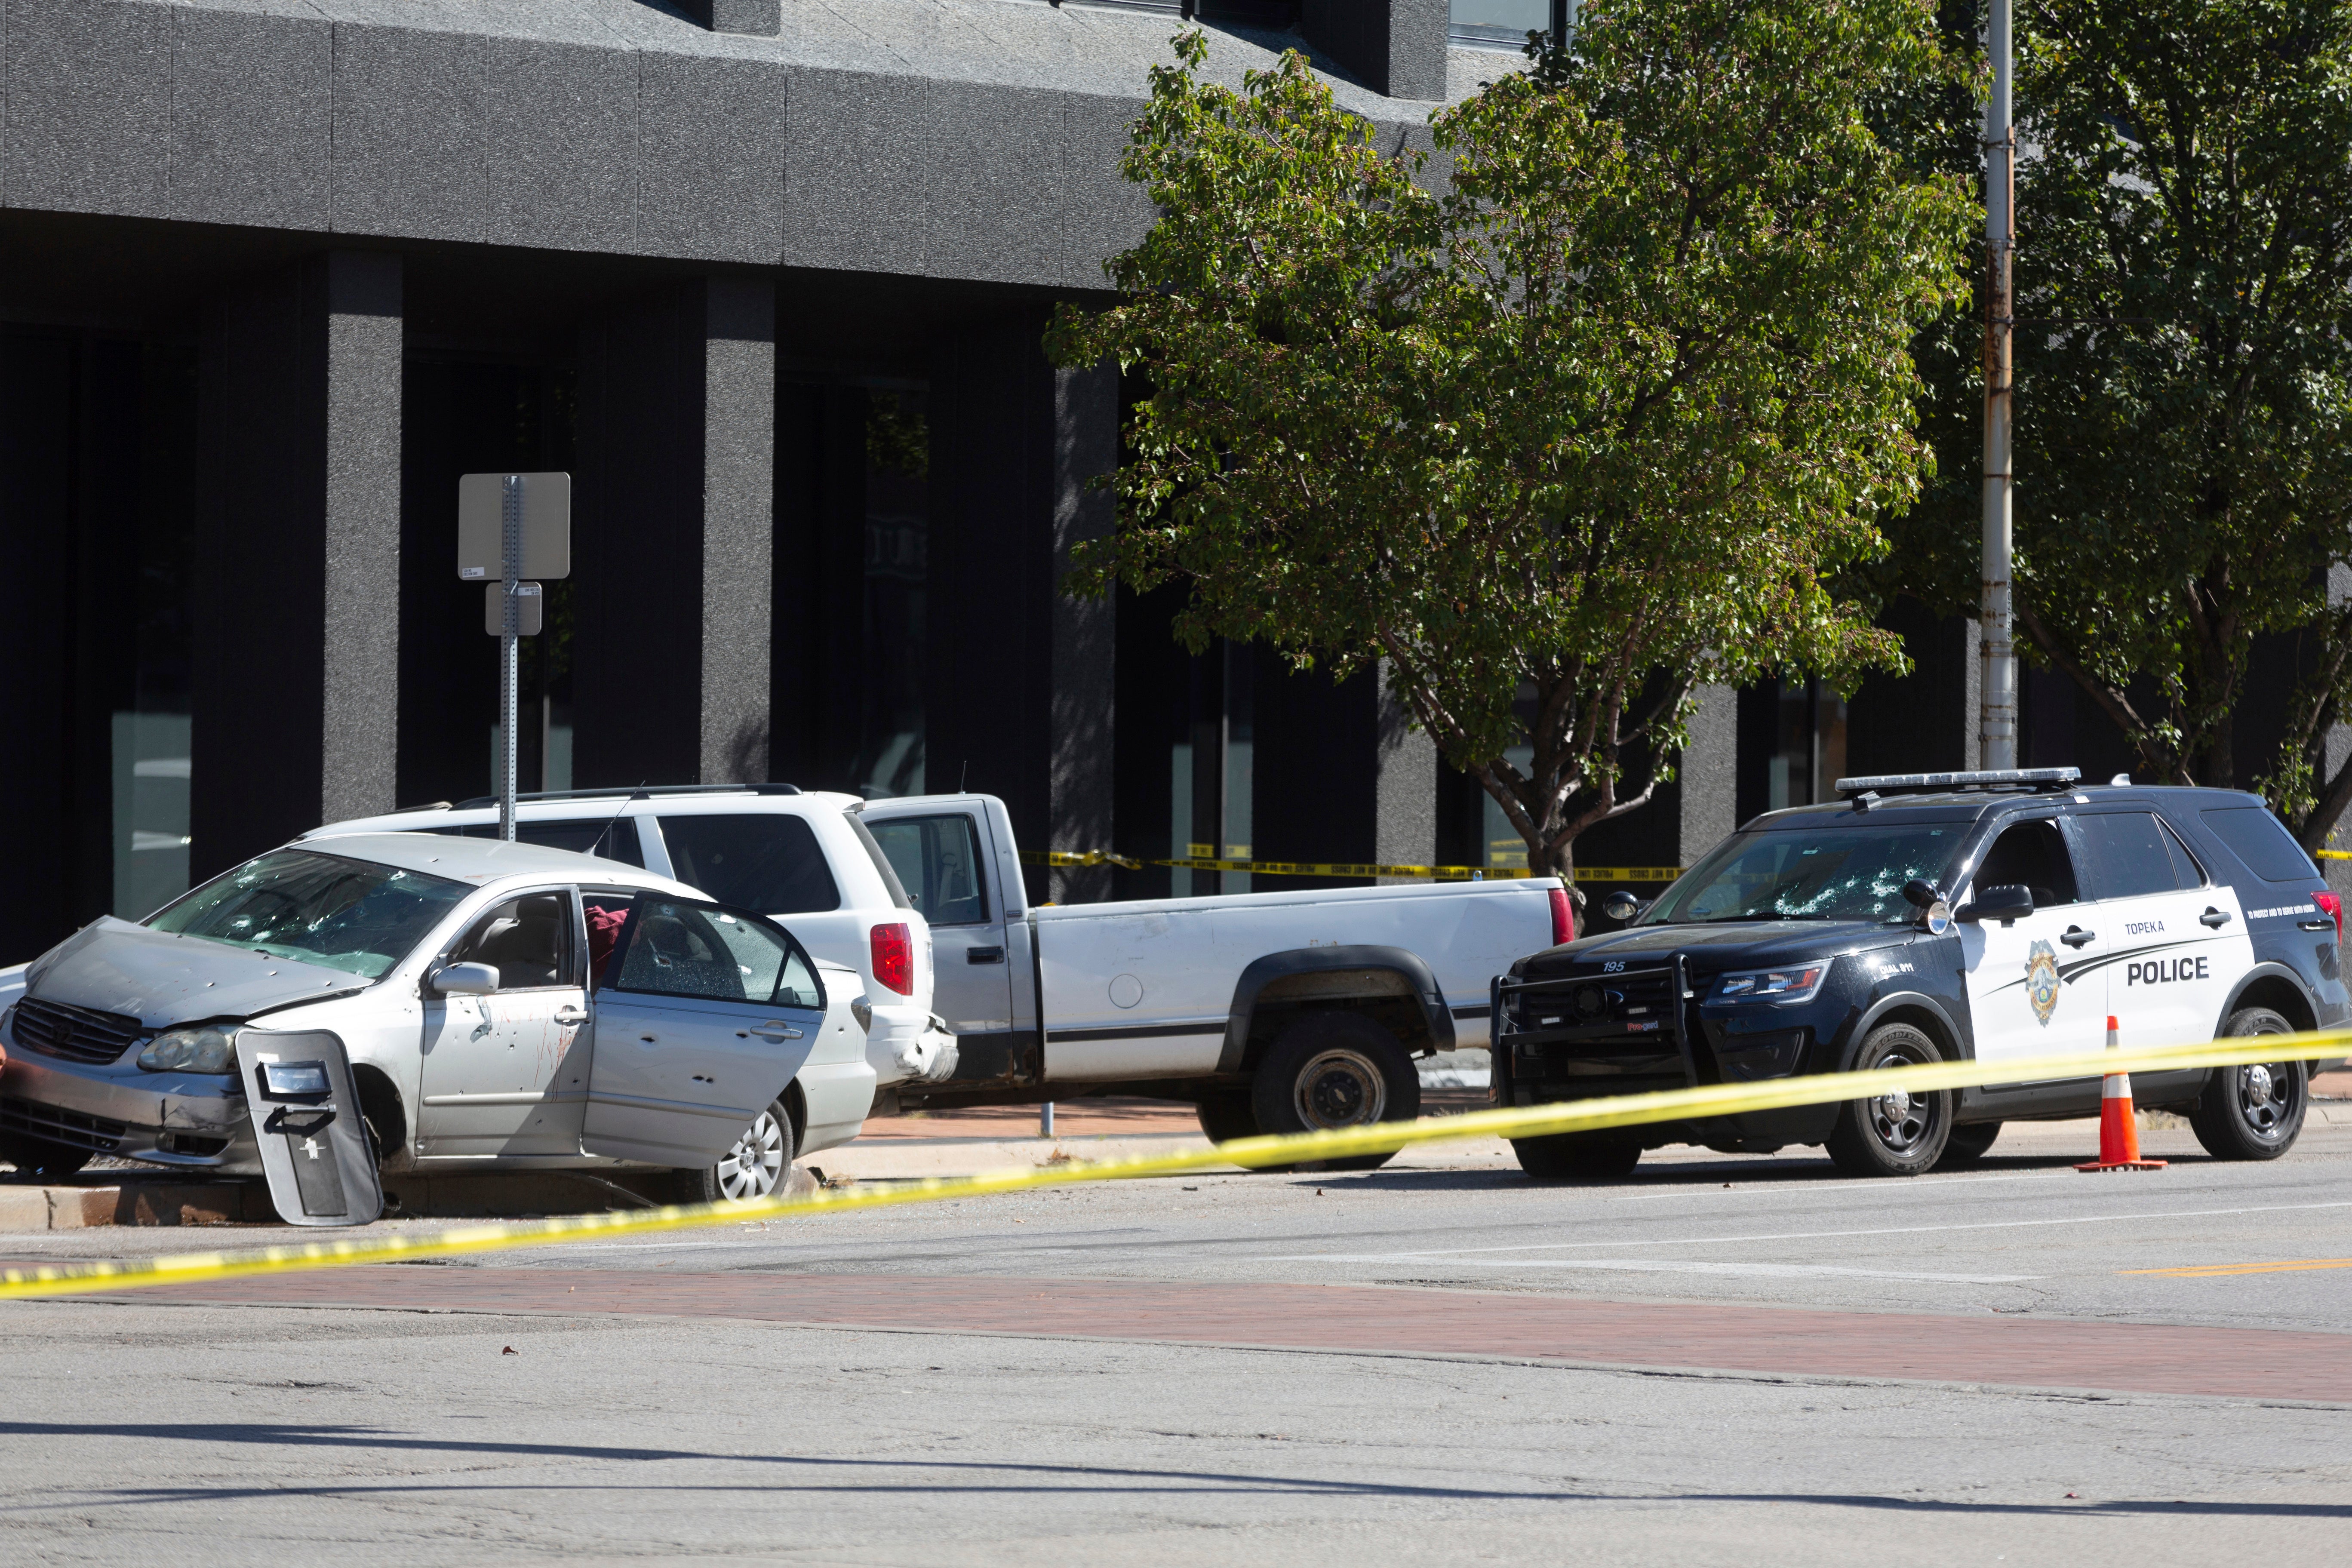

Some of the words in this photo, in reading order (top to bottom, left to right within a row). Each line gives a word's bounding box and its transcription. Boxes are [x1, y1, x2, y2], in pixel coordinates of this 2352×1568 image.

[1430, 868, 1450, 877] CROSS
[1494, 870, 1514, 878] POLICE
[1578, 870, 1590, 879] LINE
[1593, 870, 1614, 879] POLICE
[1629, 870, 1649, 879] CROSS
[1651, 870, 1663, 879] NOT
[1666, 870, 1674, 879] DO
[2247, 910, 2254, 919] TO
[2253, 908, 2269, 919] PROTECT
[2269, 907, 2278, 917] AND
[2276, 907, 2283, 916] TO
[2282, 906, 2294, 916] SERVE
[2293, 905, 2303, 914] WITH
[2303, 904, 2316, 913] HONOR
[2125, 920, 2165, 935] TOPEKA
[2032, 953, 2052, 963] OFFICER
[1604, 962, 1626, 972] 195
[1879, 964, 1900, 975] DIAL
[1899, 962, 1914, 972] 911
[2030, 962, 2041, 978] TOPEKA
[2043, 962, 2054, 975] POLICE
[2128, 956, 2210, 987] POLICE
[2033, 997, 2055, 1011] DEPARTMENT
[1875, 1032, 1932, 1051] GOODYEAR
[1903, 1148, 1936, 1170] EAGLE
